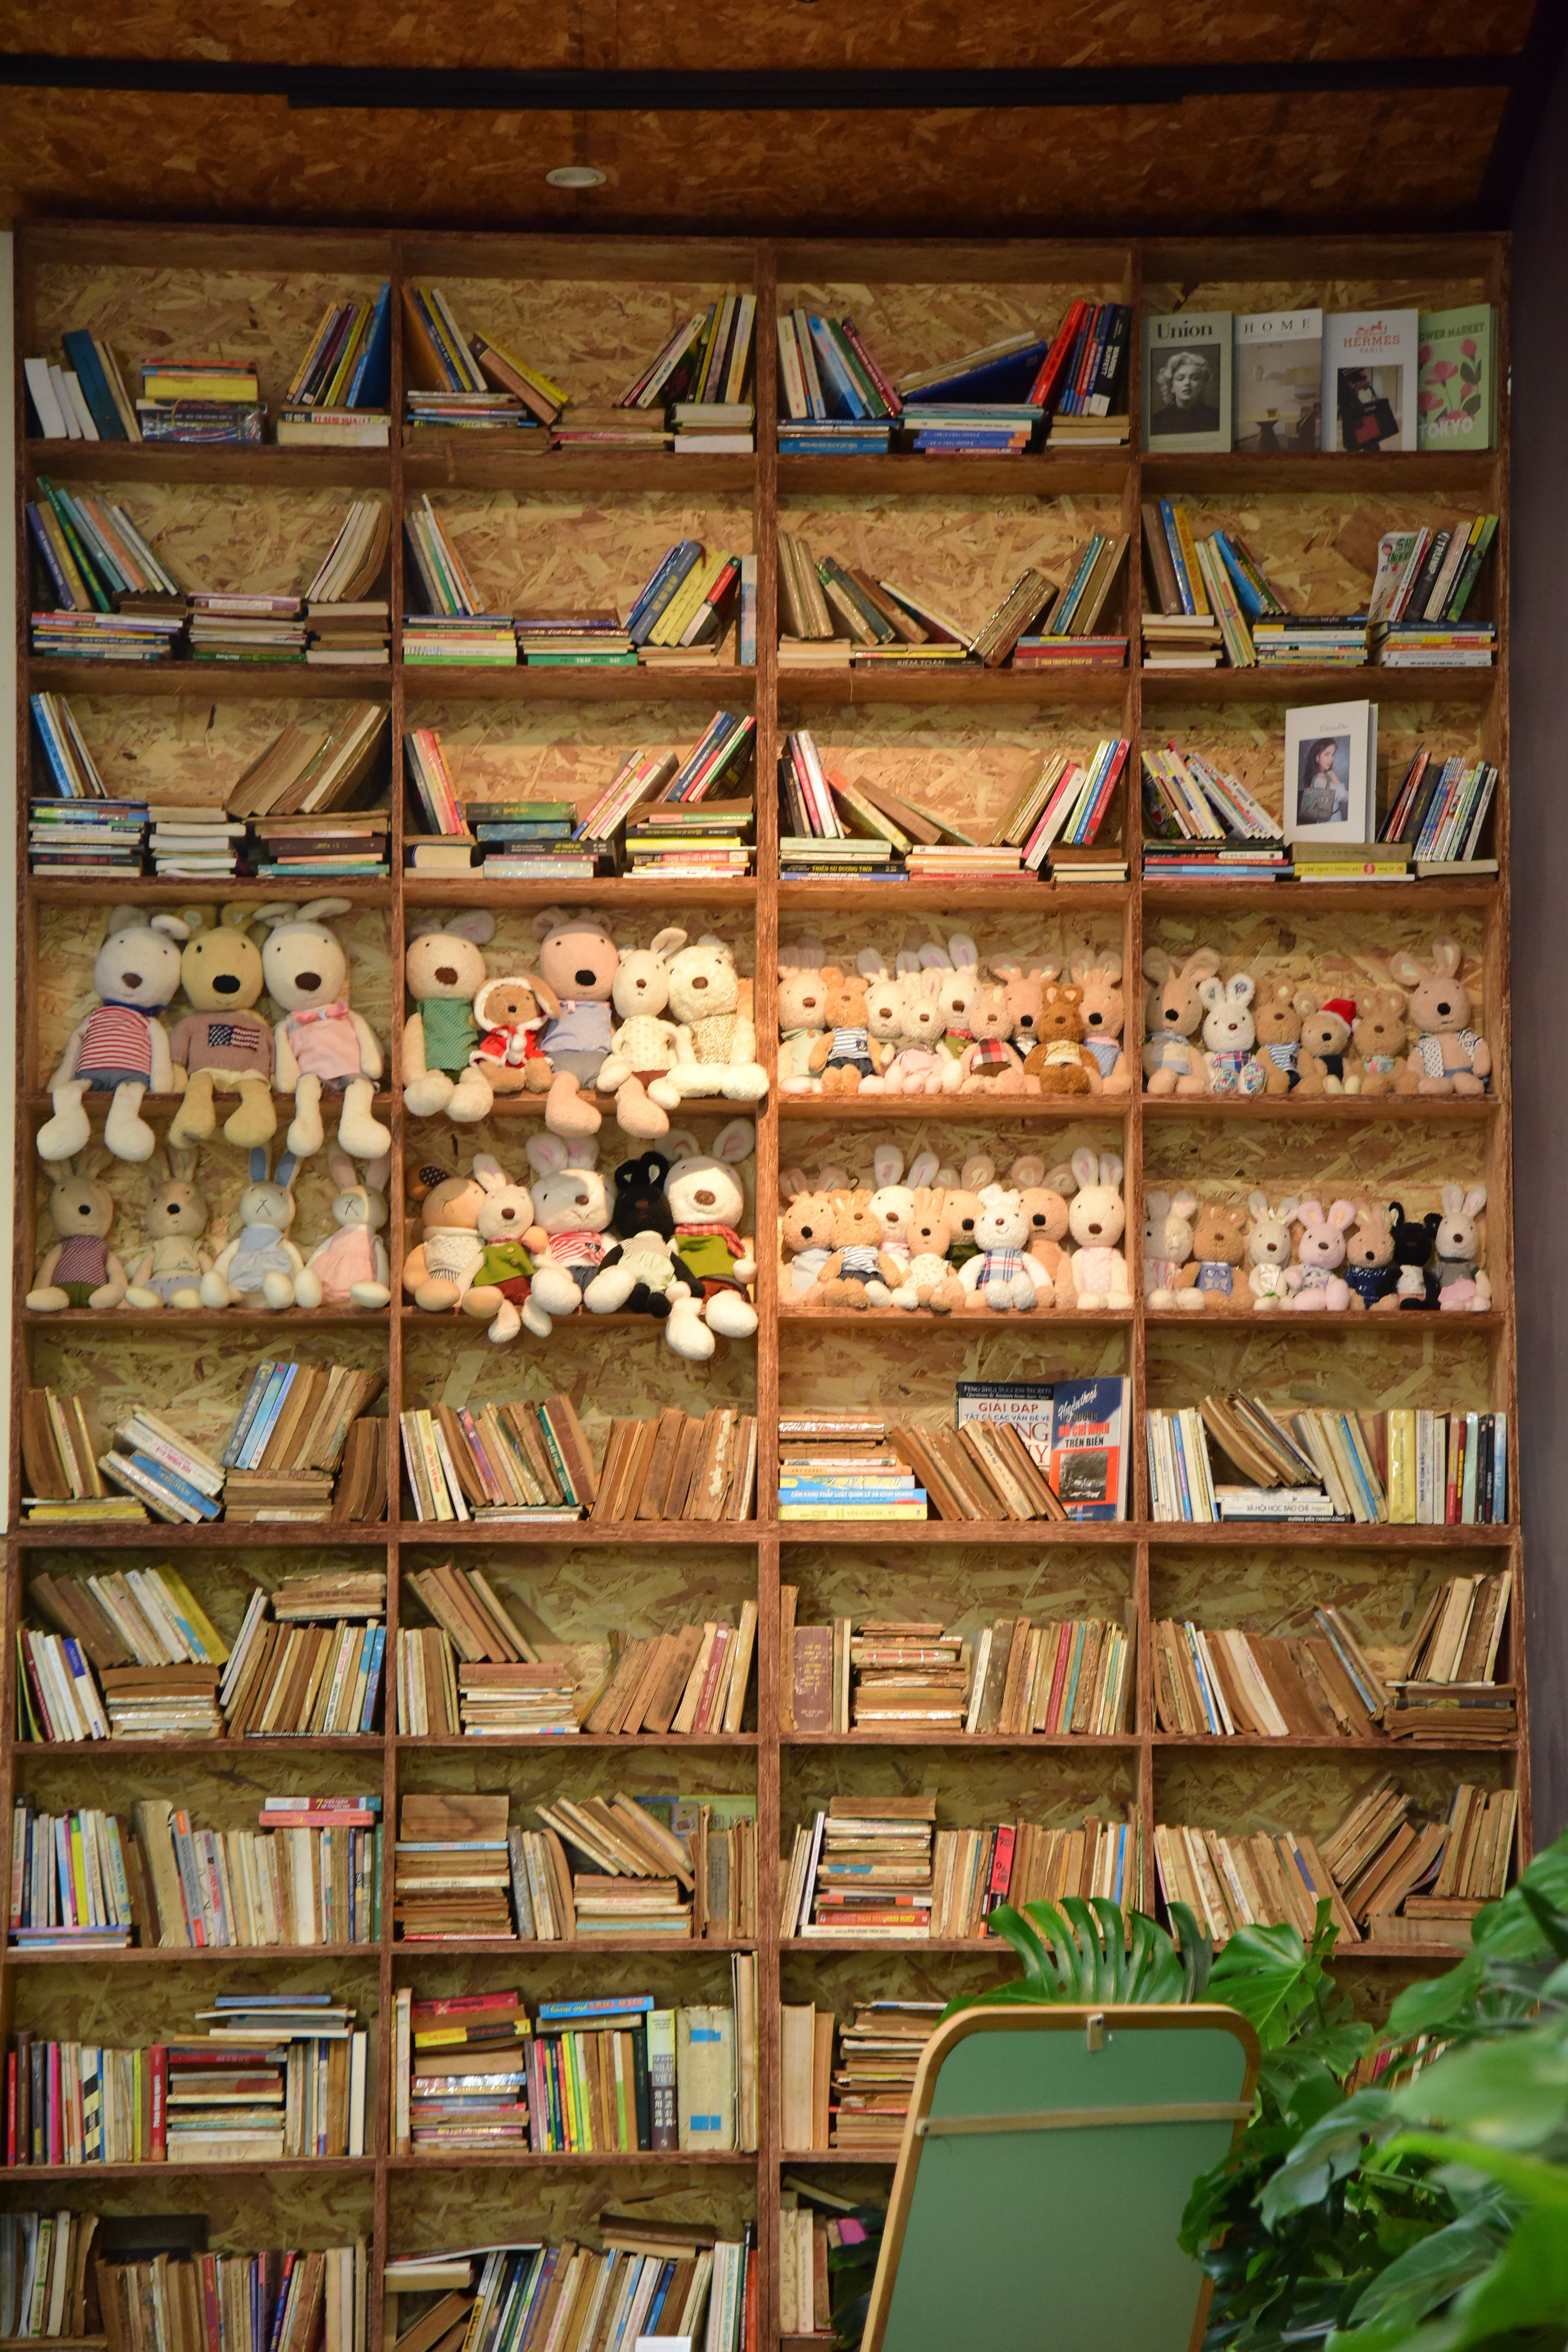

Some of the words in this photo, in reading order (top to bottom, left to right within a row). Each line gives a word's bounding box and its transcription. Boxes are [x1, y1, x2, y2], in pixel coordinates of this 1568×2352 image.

[1157, 320, 1213, 340] Union
[1244, 317, 1311, 334] HOME
[1419, 329, 1445, 343] OWER
[1447, 322, 1485, 337] MARKET
[1419, 415, 1473, 441] TOKYO
[1427, 540, 1447, 574] TRUMP
[897, 657, 919, 667] KIỂM
[920, 657, 945, 667] TOÁN
[978, 1400, 1006, 1412] GIẢI
[1010, 1401, 1038, 1413] ĐÁP
[994, 1413, 1009, 1421] CÁC
[1058, 1422, 1070, 1438] HỒ
[1072, 1420, 1086, 1437] CHÍ
[1087, 1421, 1110, 1435] MINH
[1065, 1437, 1084, 1448] TRÊN
[1085, 1434, 1104, 1447] BIỂN
[1255, 1504, 1268, 1513] HỘI
[316, 1799, 324, 1810] 7
[573, 2003, 587, 2012] phổ
[588, 2000, 615, 2011] THỨC
[618, 1997, 643, 2011] KIẾN
